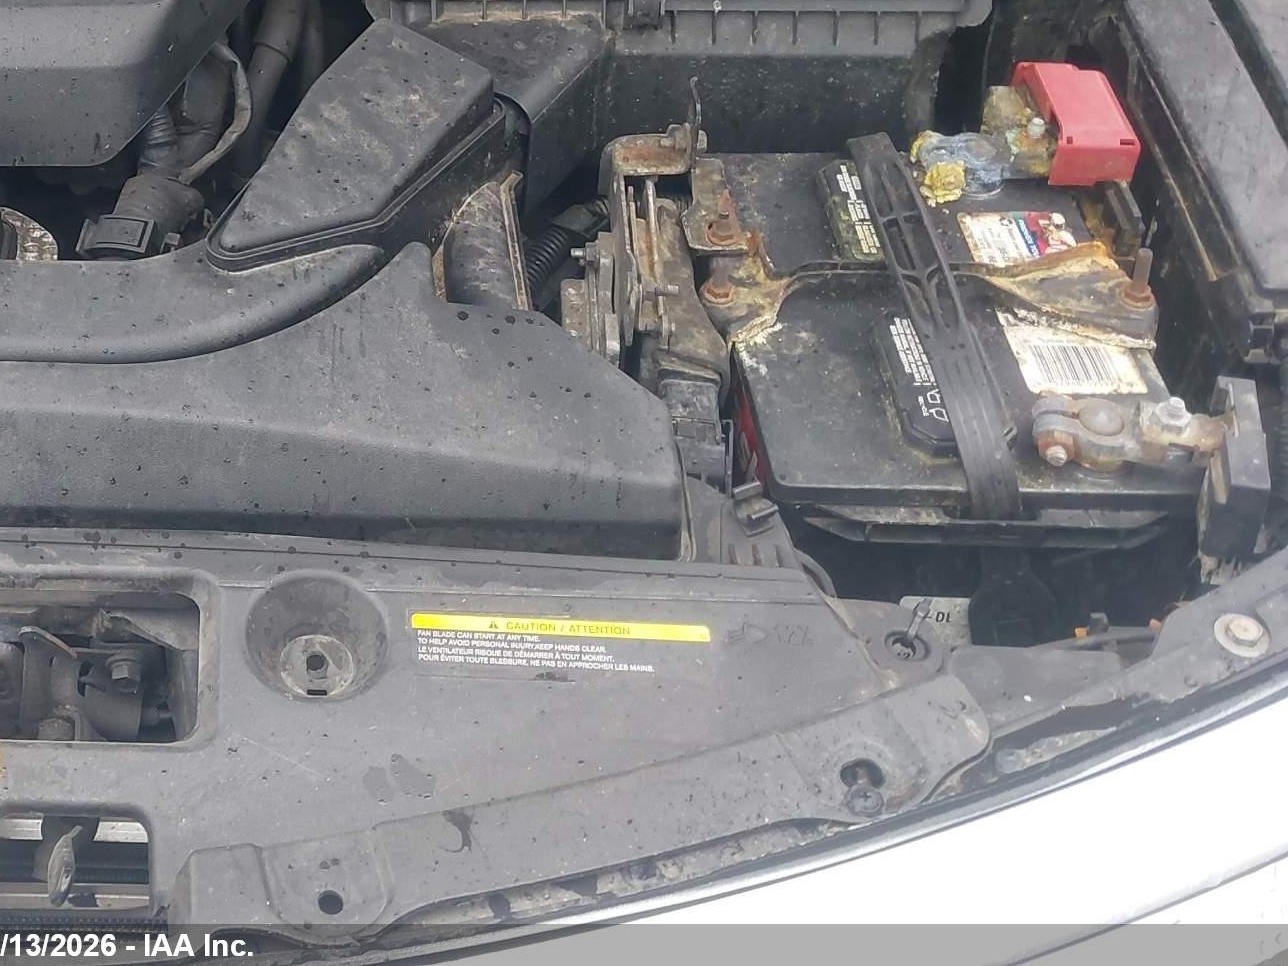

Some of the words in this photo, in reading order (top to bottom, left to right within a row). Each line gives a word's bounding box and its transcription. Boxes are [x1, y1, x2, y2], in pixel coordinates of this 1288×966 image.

[506, 621, 556, 630] CAUTION
[569, 625, 631, 634] ATTENTION
[433, 630, 455, 638] BLADE
[471, 640, 509, 648] PERSONAL
[555, 644, 580, 652] HANDS
[428, 647, 474, 655] VENTILATEUR
[568, 662, 614, 670] APPROCHER
